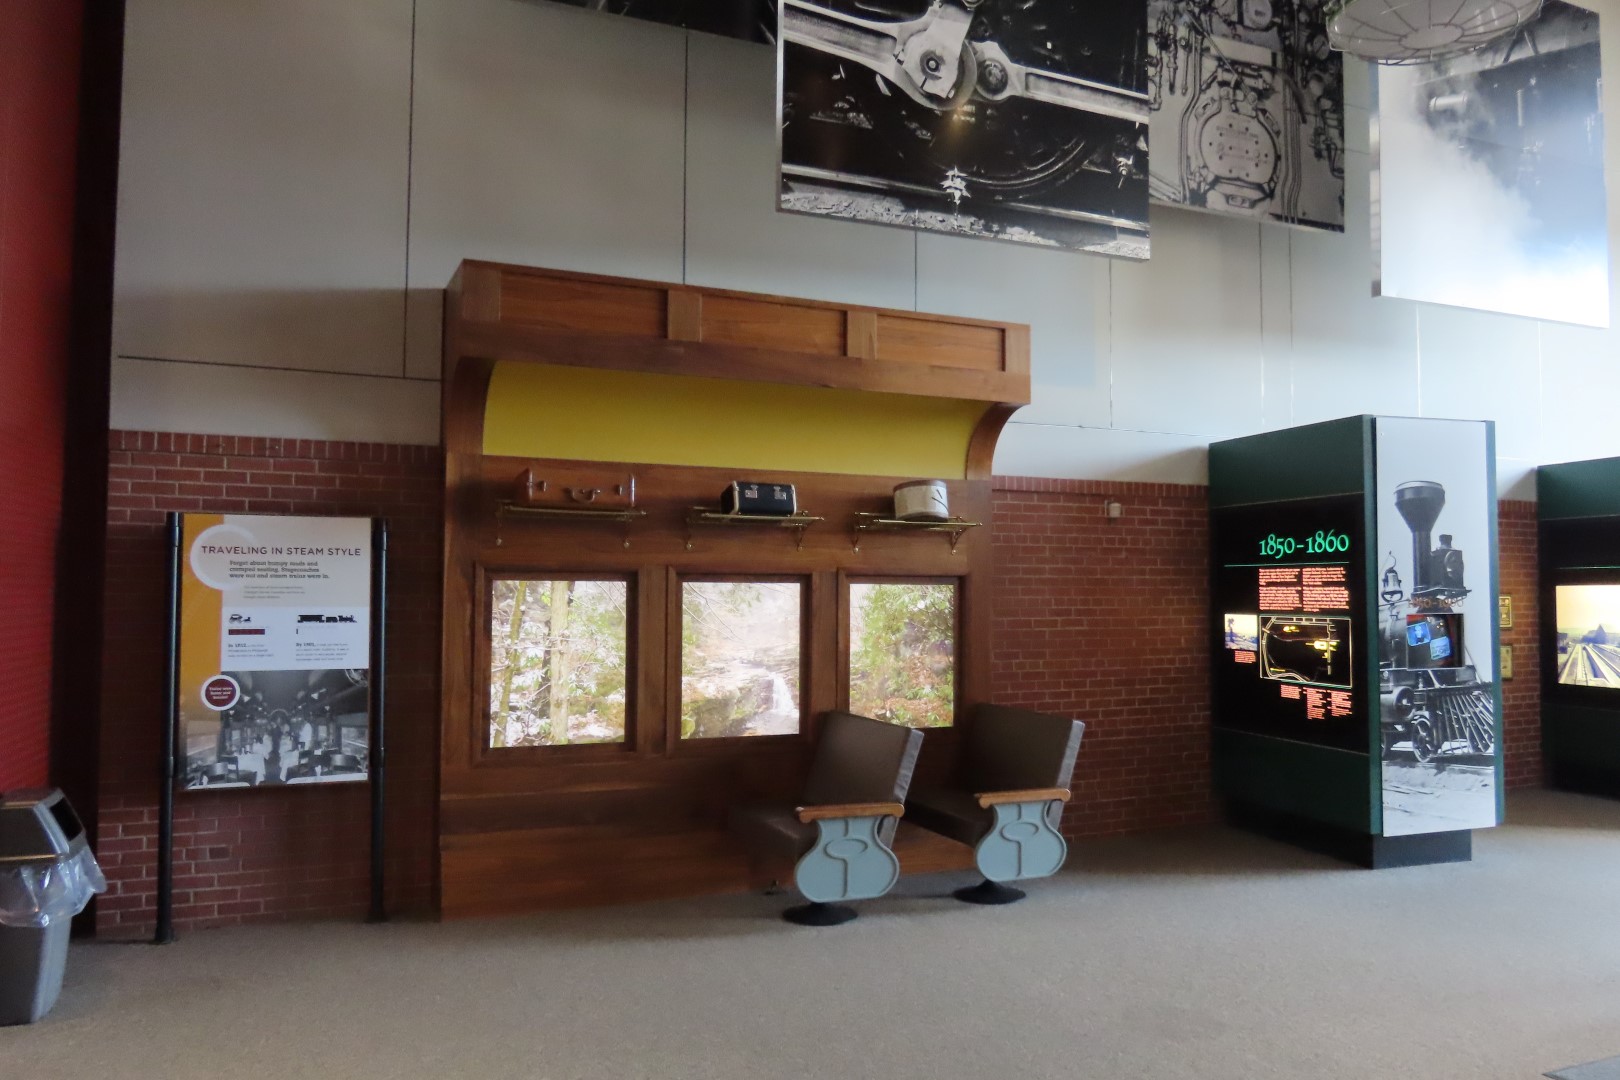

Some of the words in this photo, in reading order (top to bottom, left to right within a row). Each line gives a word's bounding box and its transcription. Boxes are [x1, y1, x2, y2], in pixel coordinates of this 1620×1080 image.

[201, 545, 268, 555] TRAVELING
[271, 546, 283, 555] IN
[286, 547, 324, 556] STEAM
[328, 548, 361, 556] STYLE
[1258, 529, 1349, 559] 1850-1860
